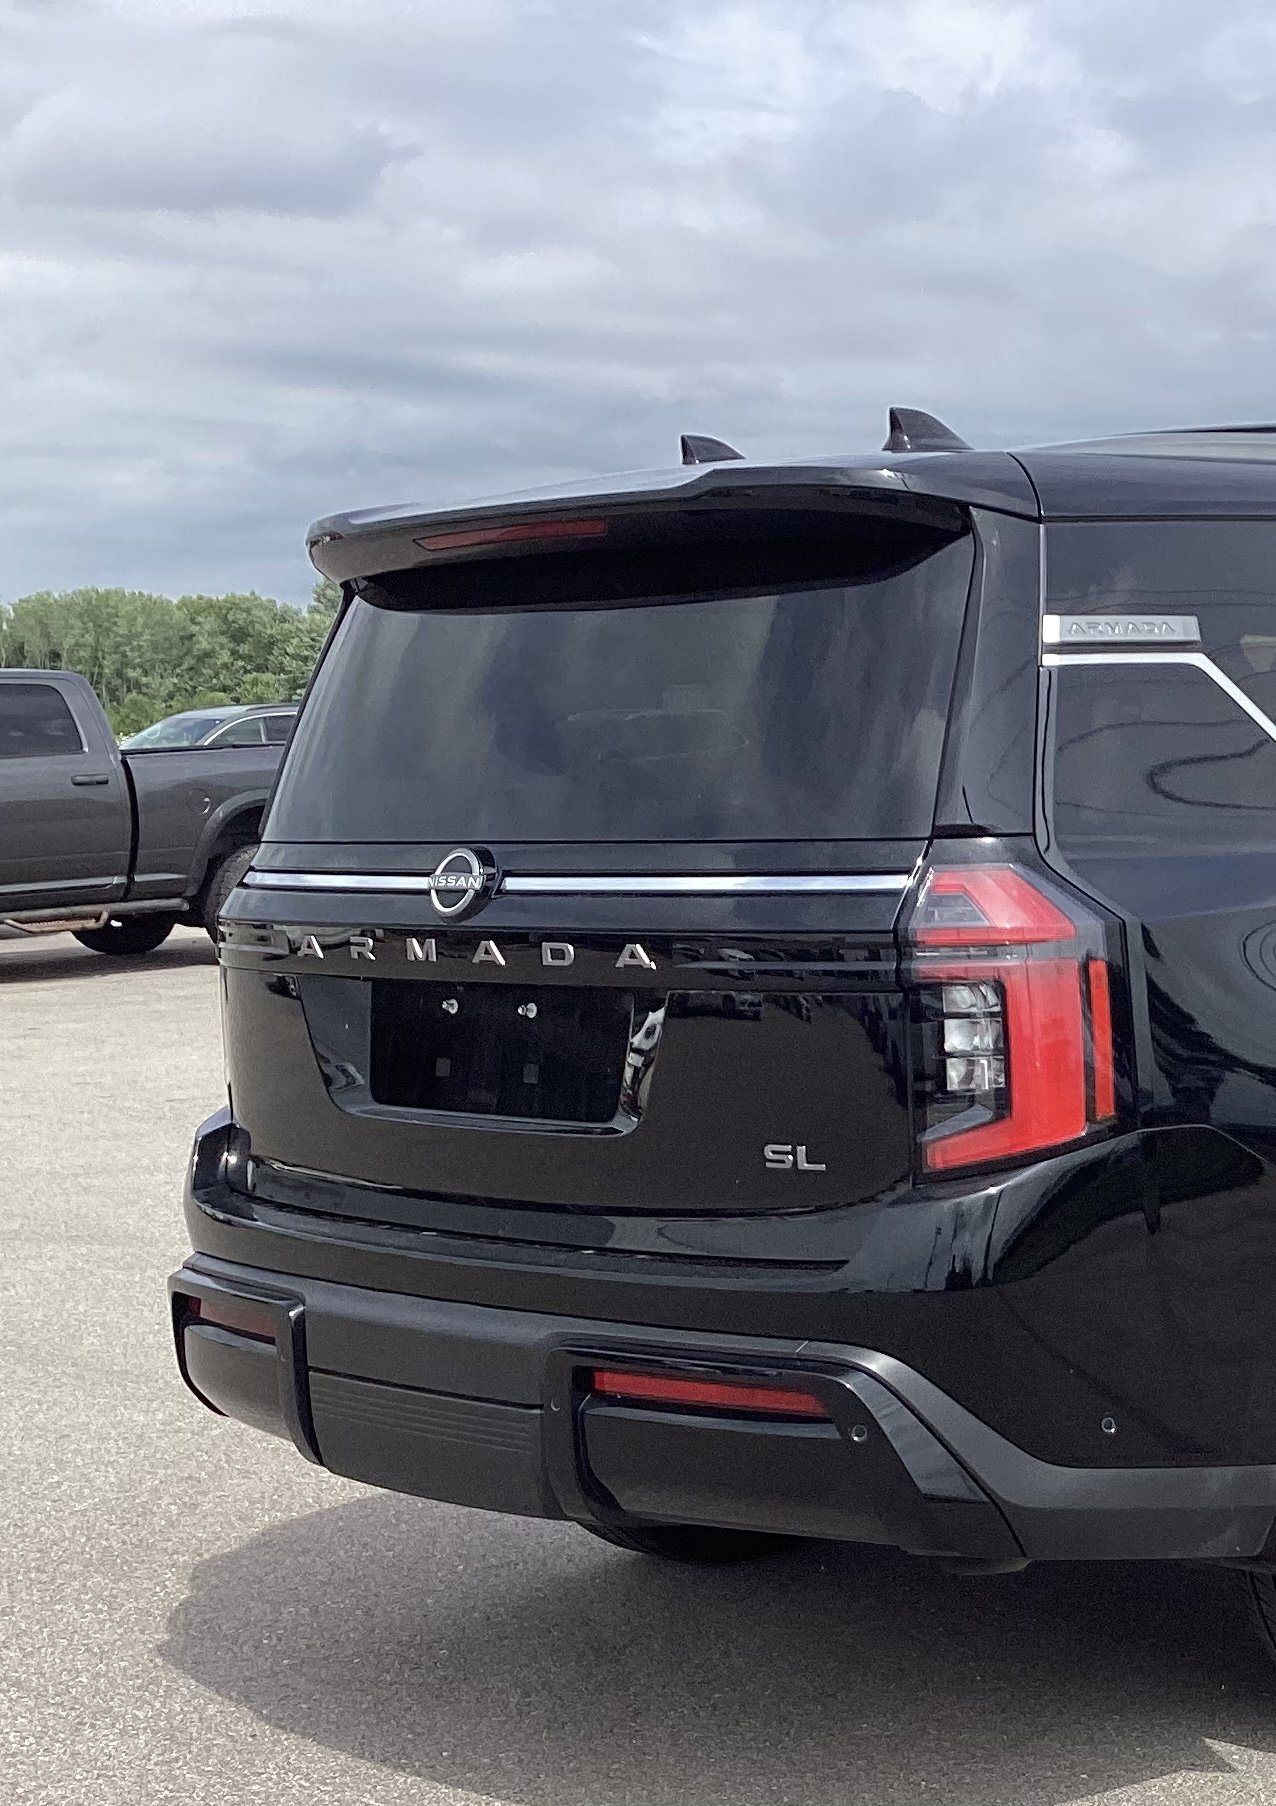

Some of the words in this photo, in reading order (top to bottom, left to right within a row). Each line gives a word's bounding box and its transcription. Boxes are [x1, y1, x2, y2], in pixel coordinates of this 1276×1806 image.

[1068, 621, 1176, 635] ARMADA
[428, 875, 480, 888] NISSAN
[297, 935, 657, 971] ARMADA
[763, 1143, 827, 1171] SL
